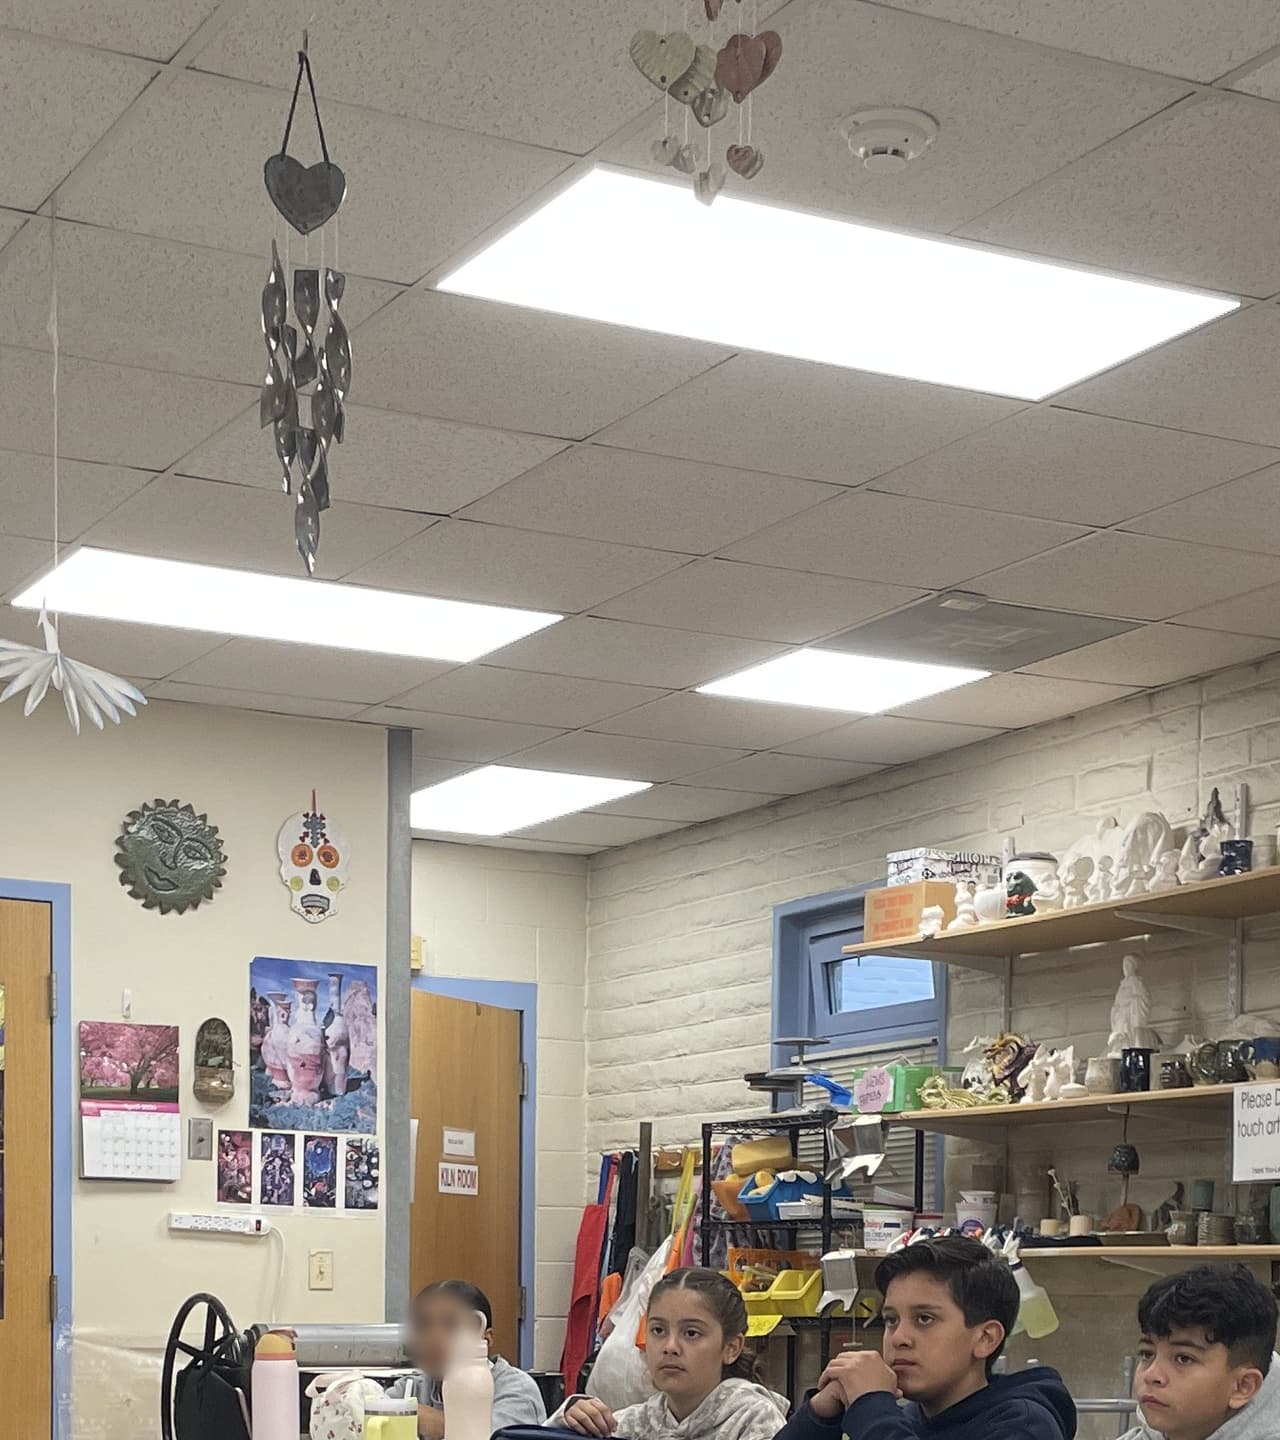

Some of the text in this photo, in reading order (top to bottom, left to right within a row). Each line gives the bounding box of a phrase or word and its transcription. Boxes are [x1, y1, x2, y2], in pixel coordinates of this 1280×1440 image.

[1241, 1091, 1273, 1109] Please
[1237, 1117, 1265, 1138] touch
[1266, 1115, 1280, 1135] art
[440, 1168, 477, 1189] KILN ROOM
